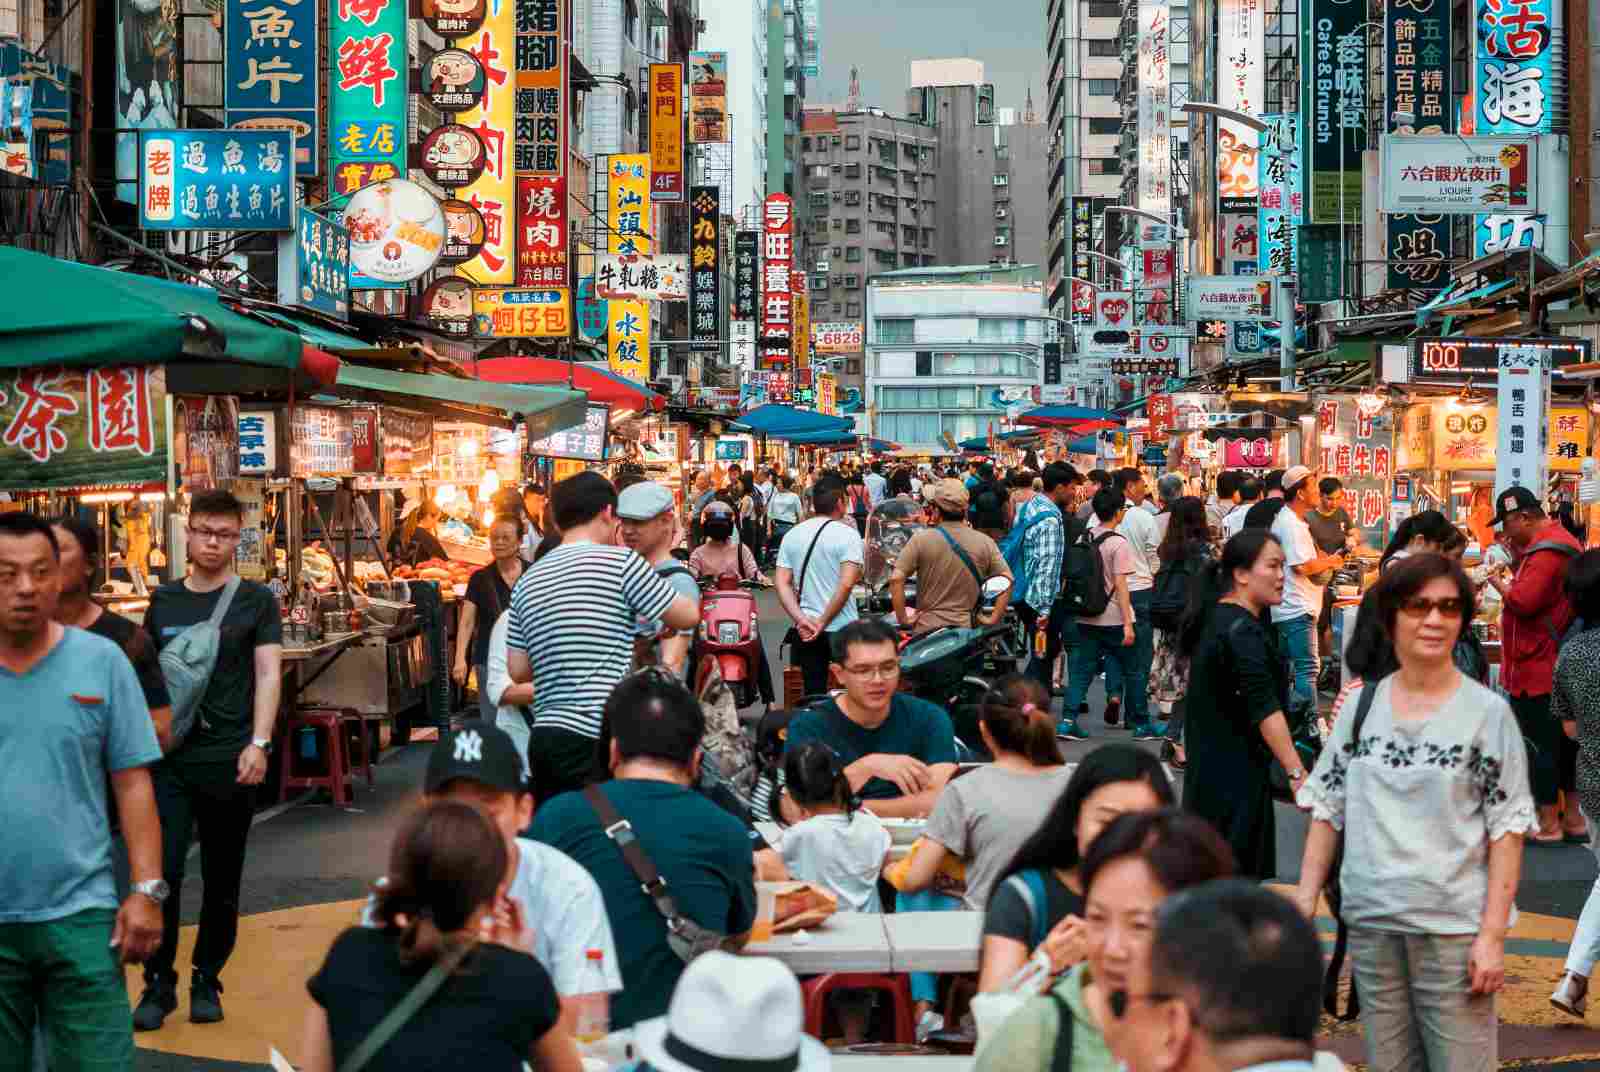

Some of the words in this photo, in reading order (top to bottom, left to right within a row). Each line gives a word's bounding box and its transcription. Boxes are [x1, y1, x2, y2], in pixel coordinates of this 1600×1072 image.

[237, 0, 304, 104] 魚片
[1394, 18, 1417, 113] 飾品百貨
[1420, 18, 1444, 117] 五金精品
[181, 139, 285, 175] 過魚湯
[339, 123, 394, 153] 老店
[147, 149, 173, 211] 老牌
[655, 175, 676, 189] 4F
[526, 187, 560, 248] 燒肉
[1394, 213, 1445, 284] 場
[493, 307, 567, 333] 蚵仔包
[615, 311, 642, 362] 水餃
[0, 366, 154, 462] 茶園
